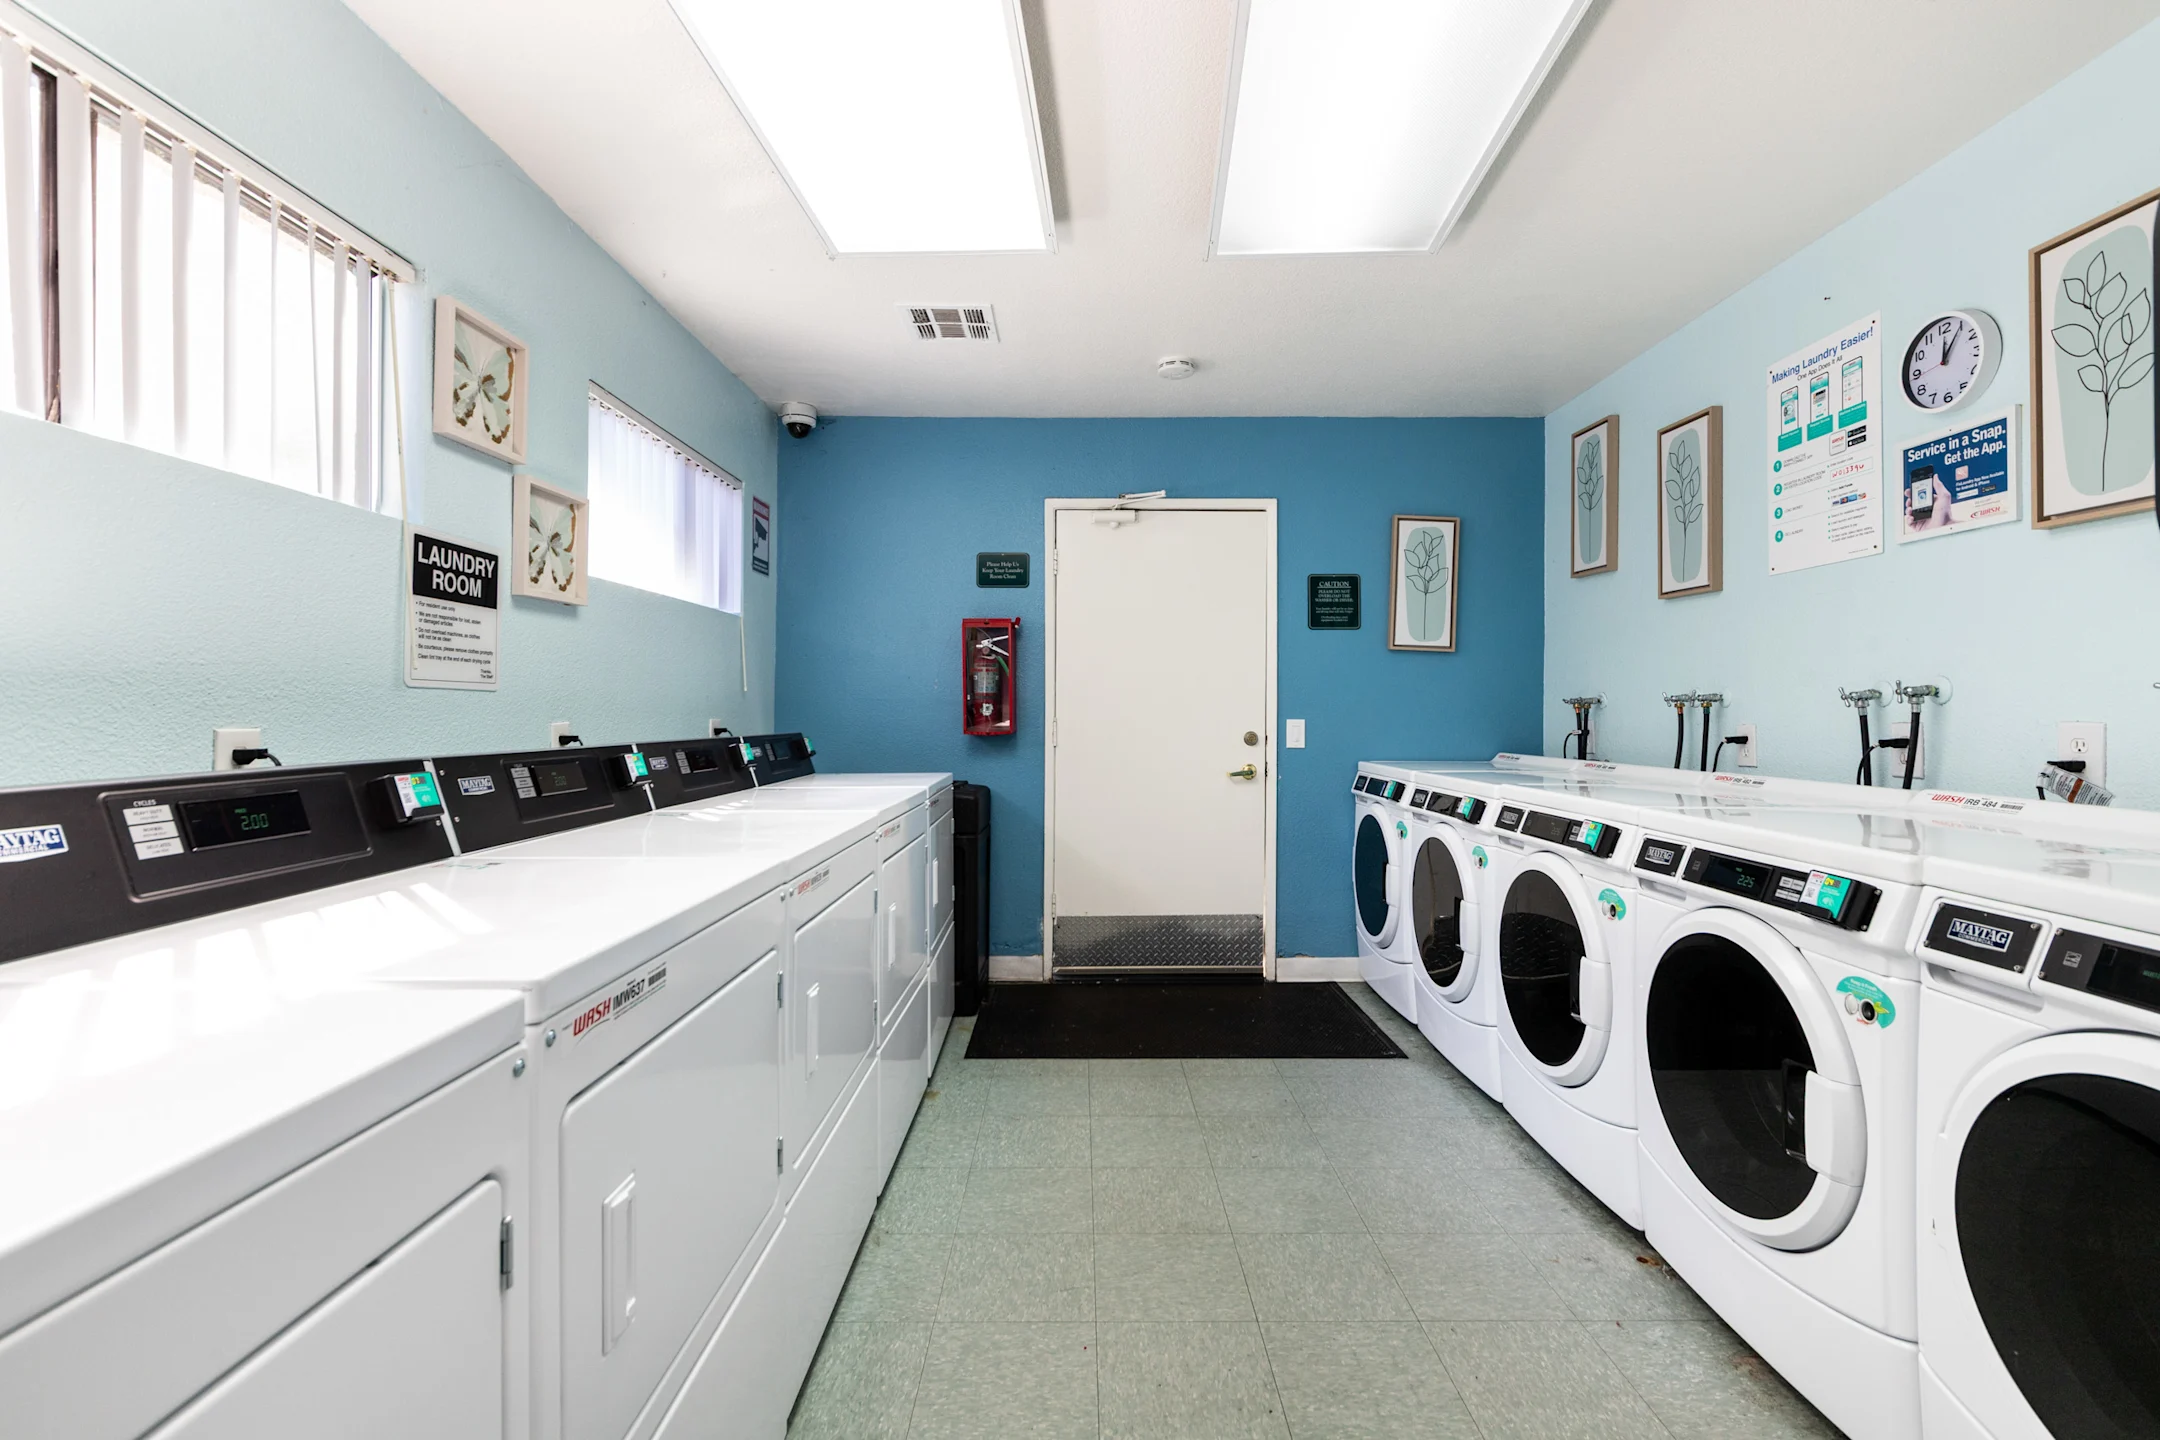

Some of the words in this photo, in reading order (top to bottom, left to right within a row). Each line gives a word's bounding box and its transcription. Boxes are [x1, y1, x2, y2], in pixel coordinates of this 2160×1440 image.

[1939, 322, 1951, 336] 12
[1925, 333, 1932, 345] 11
[1772, 364, 1800, 384] Making
[1802, 346, 1838, 369] Laundry
[1840, 326, 1874, 351] Easier!
[1915, 350, 1925, 362] 10
[1808, 368, 1817, 376] App
[1818, 362, 1831, 371] Does
[1912, 369, 1922, 380] 9
[1917, 384, 1926, 395] 8
[1928, 392, 1937, 404] 7
[1944, 392, 1953, 403] 6
[1908, 442, 1946, 462] Service
[1949, 437, 1959, 450] in
[1962, 436, 1969, 446] a
[1972, 425, 2006, 443] Snap.
[1944, 451, 1961, 465] Get
[1963, 447, 1979, 460] the
[1981, 440, 2006, 455] App.
[418, 542, 496, 578] LAUNDRY
[432, 570, 482, 598] ROOM
[461, 778, 491, 788] MAYTAG
[133, 799, 156, 807] CYCLES
[1931, 794, 1965, 804] WASH
[1964, 798, 1980, 806] IRB
[1982, 800, 1998, 808] 484
[240, 813, 269, 830] 2.00
[0, 828, 60, 848] AYTAG
[1648, 848, 1672, 861] MAYTAG
[1952, 922, 2008, 944] MAYTAG
[1958, 933, 1994, 946] COMMERCIAL
[573, 997, 612, 1036] WASH
[613, 978, 645, 1011] IMW637
